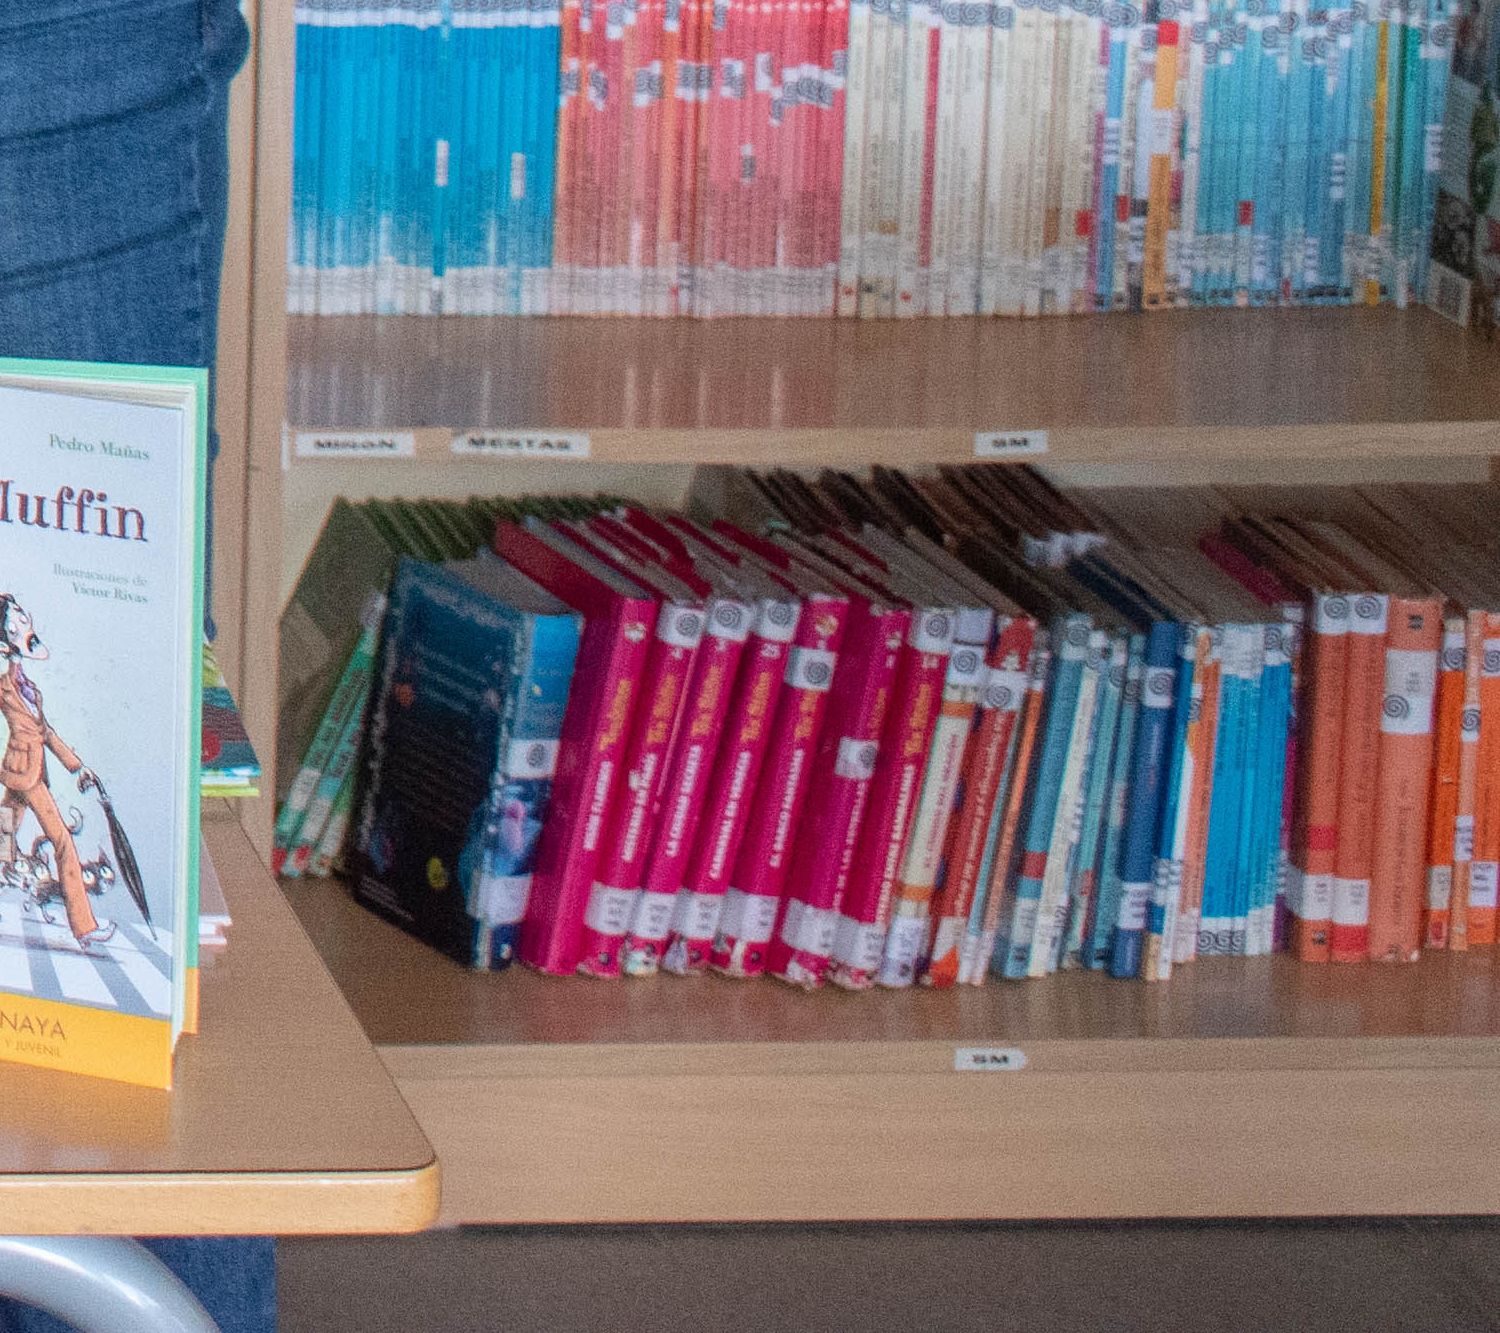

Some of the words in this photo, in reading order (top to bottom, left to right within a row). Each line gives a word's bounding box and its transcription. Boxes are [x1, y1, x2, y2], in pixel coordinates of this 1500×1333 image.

[49, 432, 95, 453] Pedro
[99, 440, 150, 462] Mañas
[131, 574, 148, 588] de
[113, 587, 149, 605] Rivas
[14, 1038, 62, 1059] JUVENIL
